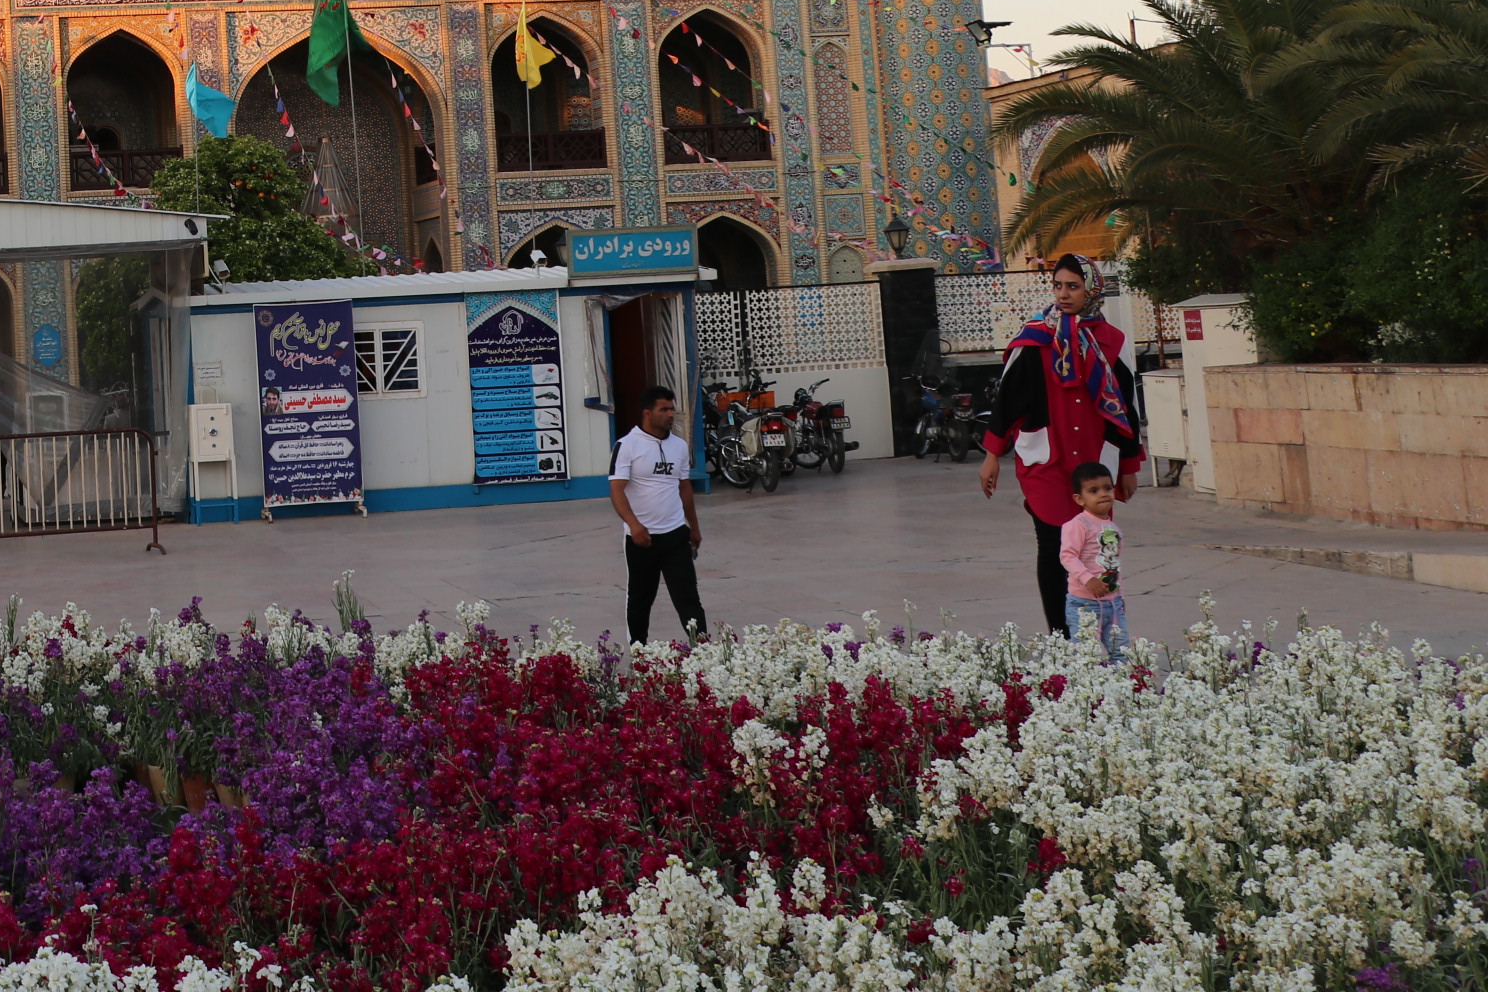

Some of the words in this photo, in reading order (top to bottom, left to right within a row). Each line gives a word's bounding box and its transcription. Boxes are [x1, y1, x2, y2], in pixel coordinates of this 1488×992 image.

[575, 236, 634, 260] برادران
[638, 238, 690, 257] ورودی
[284, 396, 308, 411] حسینی
[307, 392, 332, 410] مصطفی
[316, 471, 332, 481] حضرت
[344, 471, 355, 480] حرم
